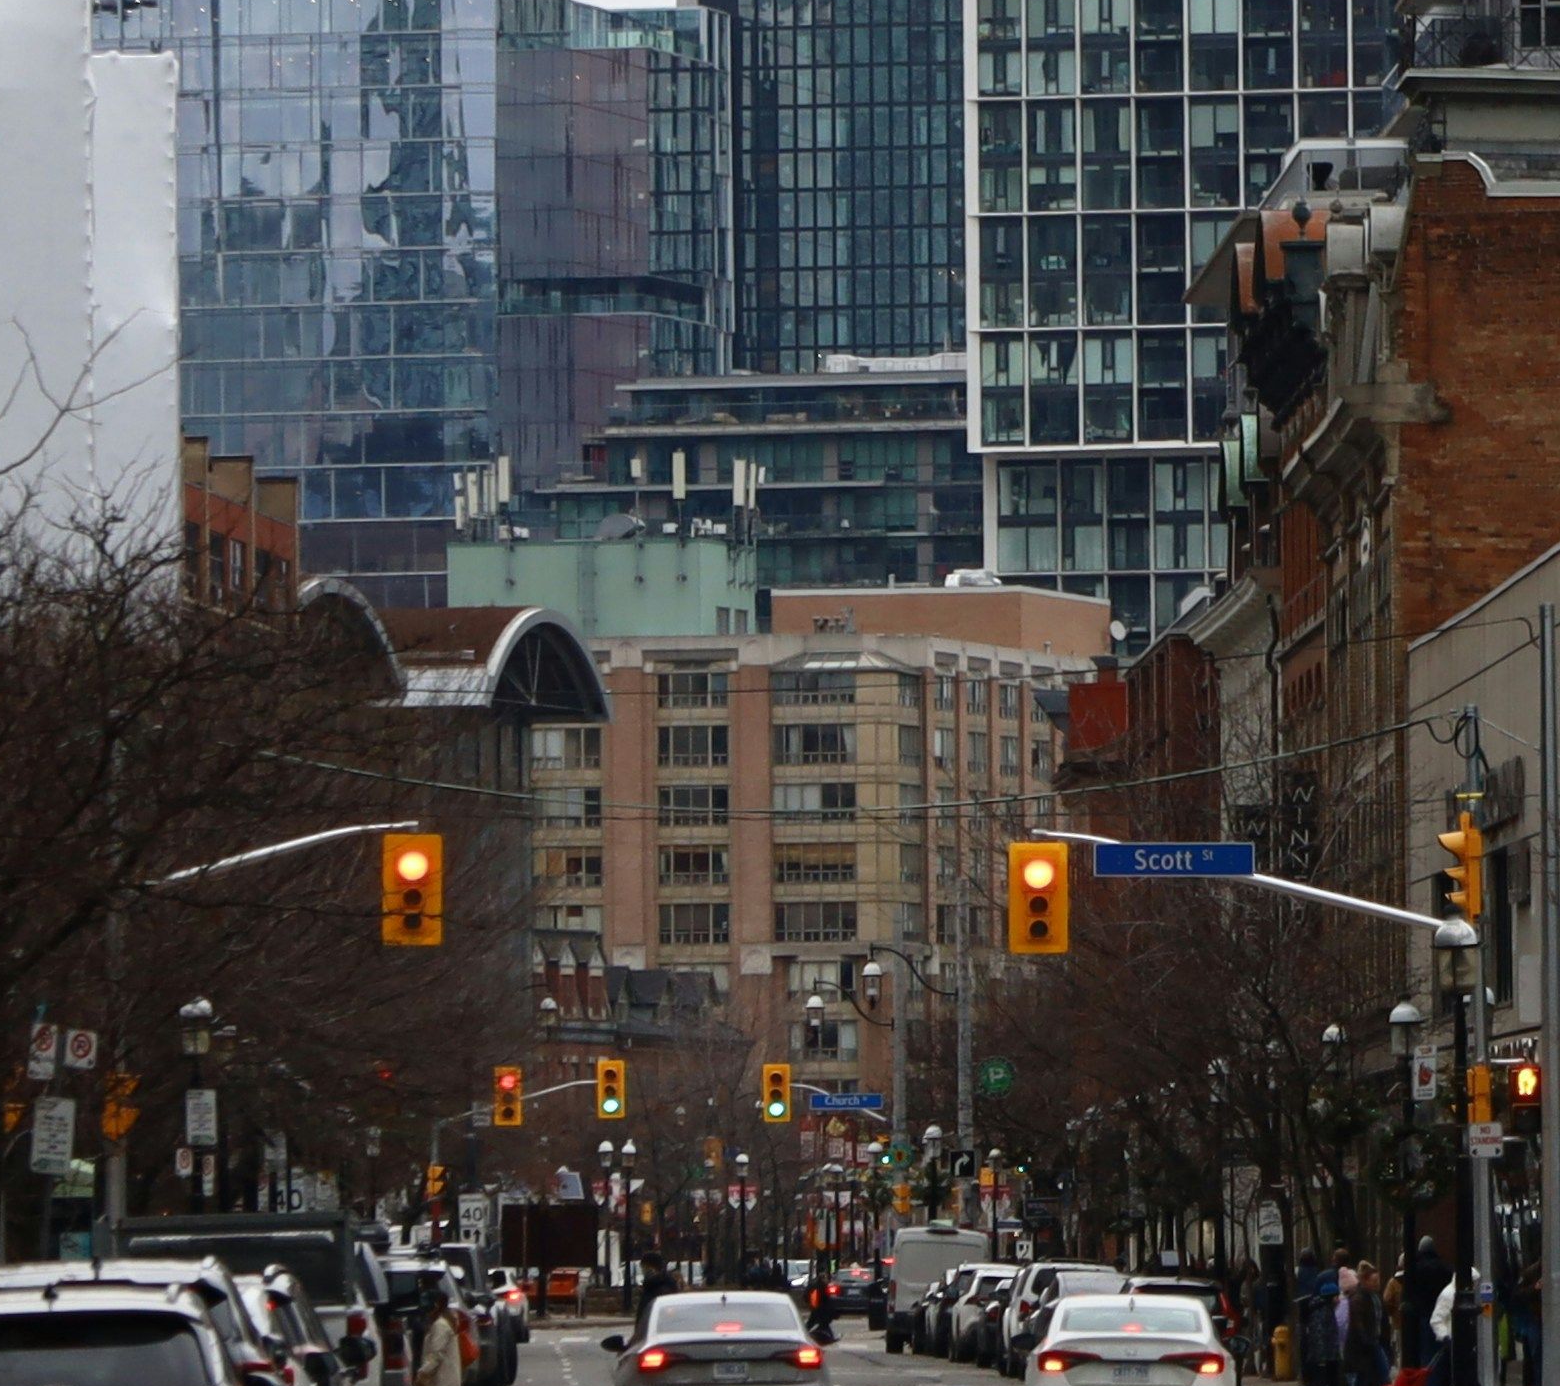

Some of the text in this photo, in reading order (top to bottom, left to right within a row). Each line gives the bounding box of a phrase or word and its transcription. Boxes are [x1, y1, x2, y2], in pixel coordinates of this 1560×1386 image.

[1134, 848, 1214, 871] Scott St
[824, 1095, 861, 1106] Church
[461, 1207, 483, 1222] 40
